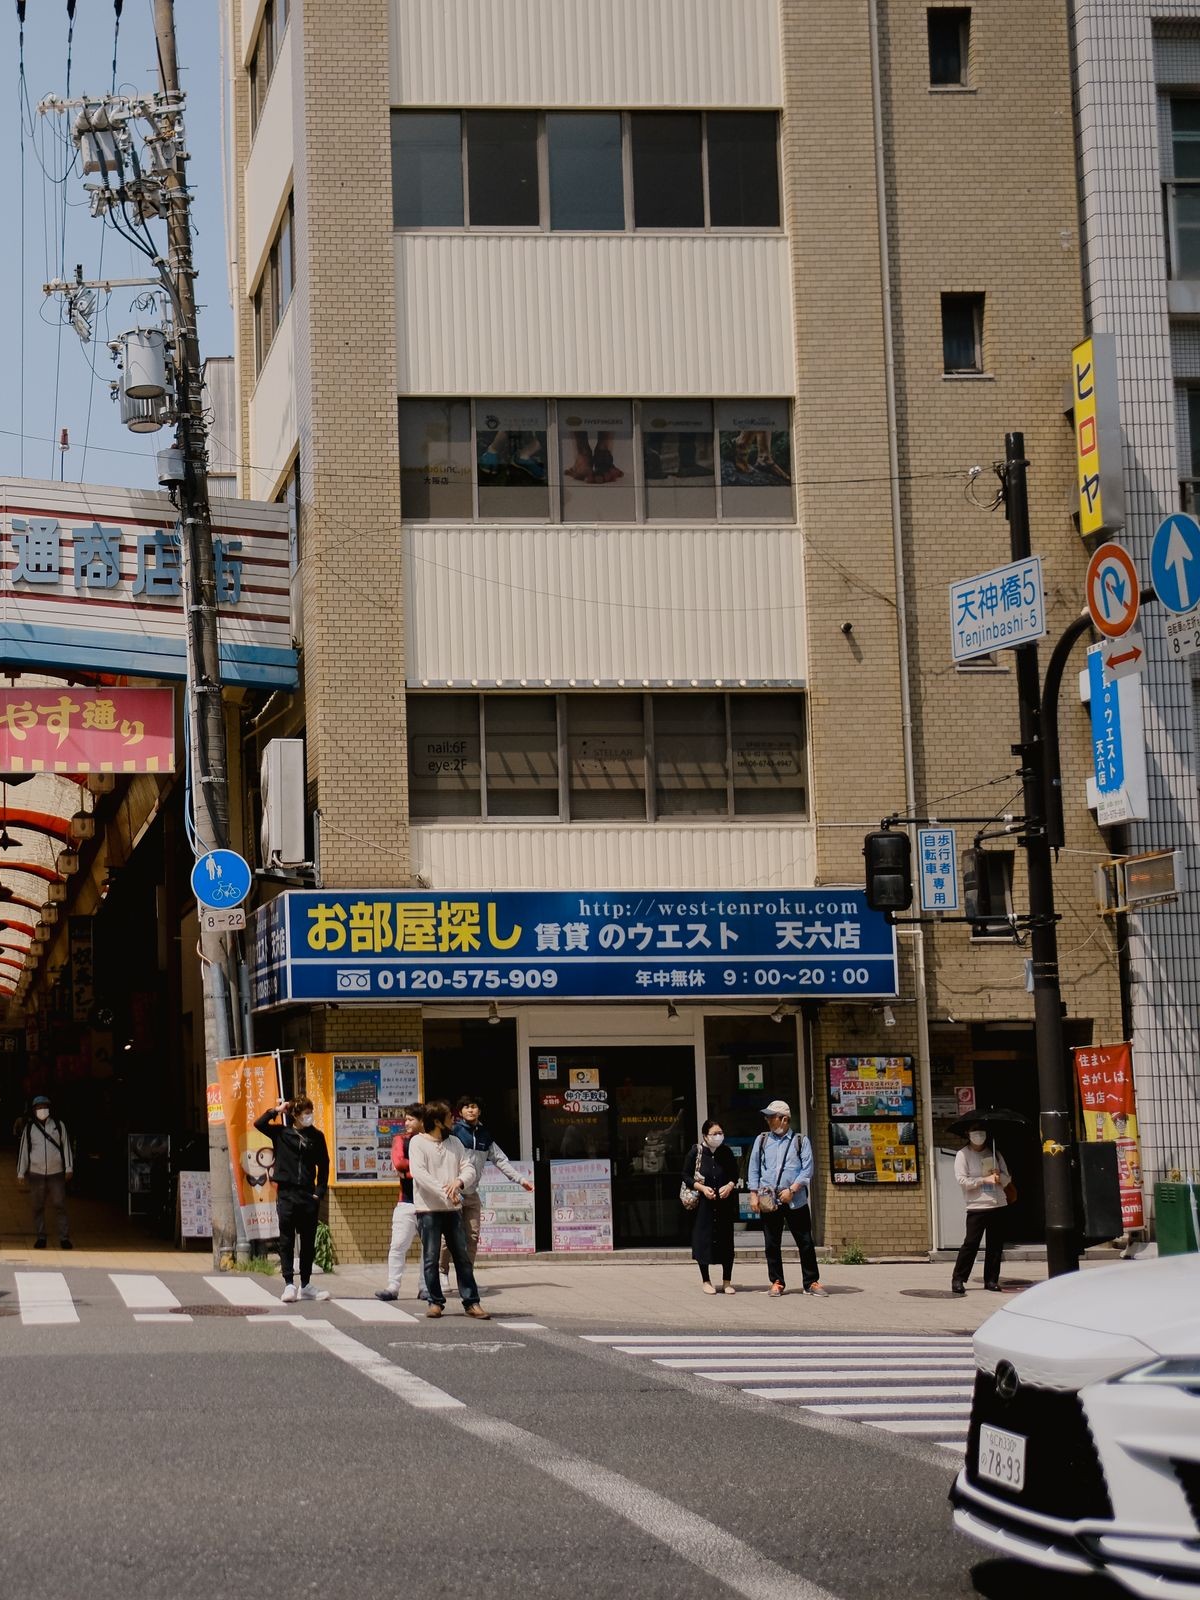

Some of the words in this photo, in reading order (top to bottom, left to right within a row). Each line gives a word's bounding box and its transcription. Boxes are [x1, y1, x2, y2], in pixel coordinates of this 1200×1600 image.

[1076, 362, 1100, 514] ヒロヤ
[956, 568, 1036, 626] 天神橋5
[958, 608, 1037, 649] Tenjinbashi-5
[1095, 740, 1107, 786] 天六店
[924, 835, 937, 876] 自転車
[937, 834, 951, 875] 歩行者
[933, 878, 946, 905] 専用
[207, 913, 243, 929] 8-22
[578, 897, 859, 919] http://west-tenroku.com
[307, 900, 522, 954] お部屋探し
[775, 920, 862, 950] 天六店
[377, 969, 559, 990] 0120-575-909
[635, 969, 706, 988] 年中無休
[1078, 1053, 1111, 1067] 住まい
[566, 1091, 606, 1101] 仲介手数料
[842, 1081, 863, 1090] 大人気
[989, 1448, 1021, 1484] 78-93
